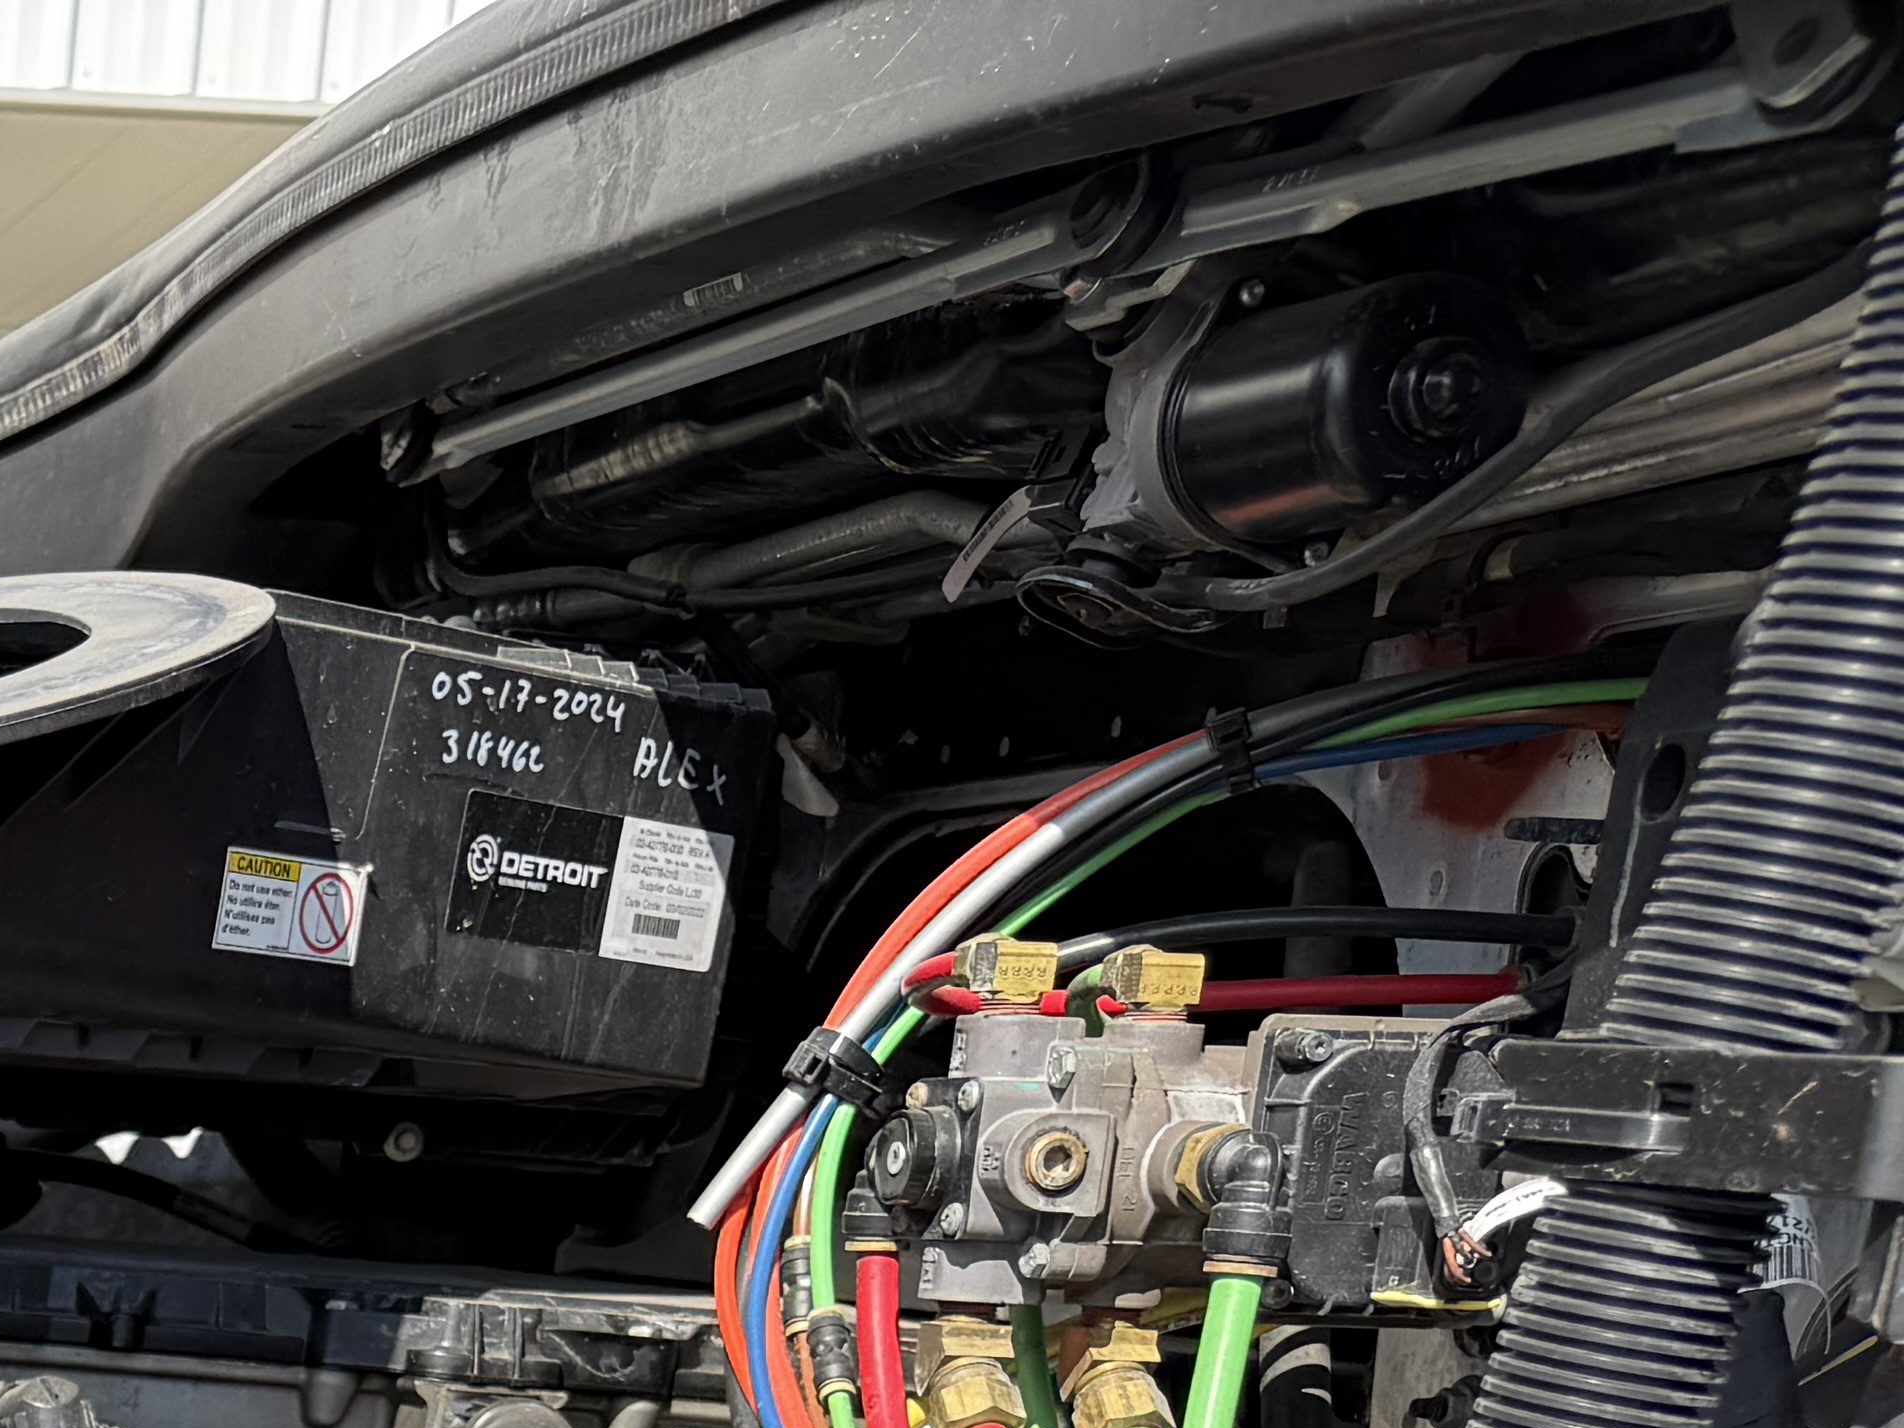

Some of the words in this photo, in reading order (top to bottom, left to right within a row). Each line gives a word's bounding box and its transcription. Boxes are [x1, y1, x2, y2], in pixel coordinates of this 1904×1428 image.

[432, 671, 625, 733] 05-17-2024
[633, 737, 727, 806] ALEX
[237, 856, 291, 878] CAUTION
[500, 851, 608, 888] DETROIT
